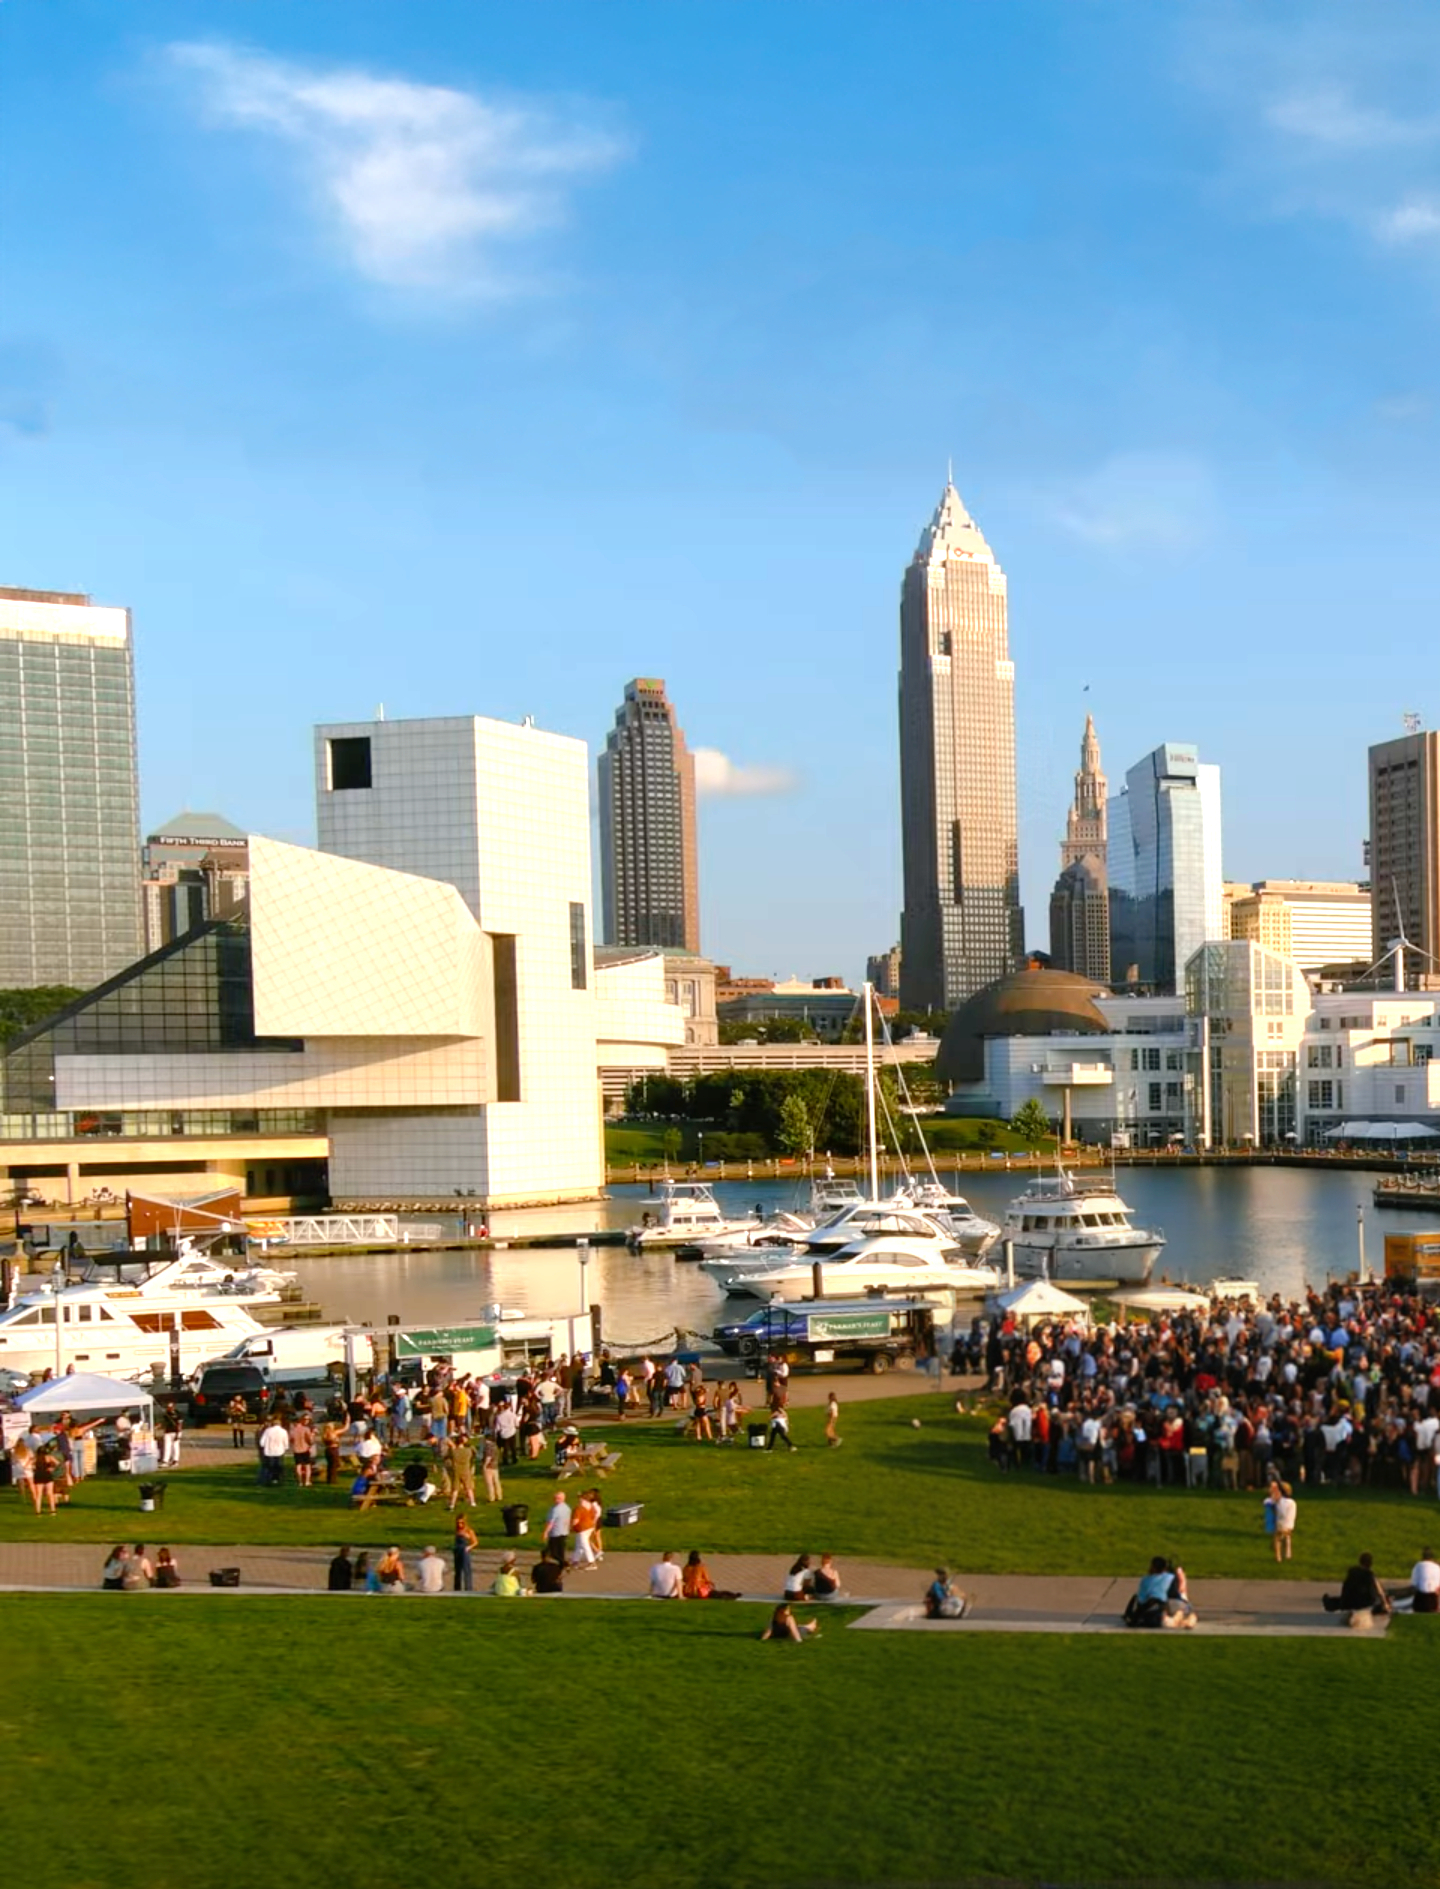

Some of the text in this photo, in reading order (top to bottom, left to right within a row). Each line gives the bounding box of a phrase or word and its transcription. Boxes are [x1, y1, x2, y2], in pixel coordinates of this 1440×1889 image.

[160, 837, 246, 847] FIFTH THIRD BANK
